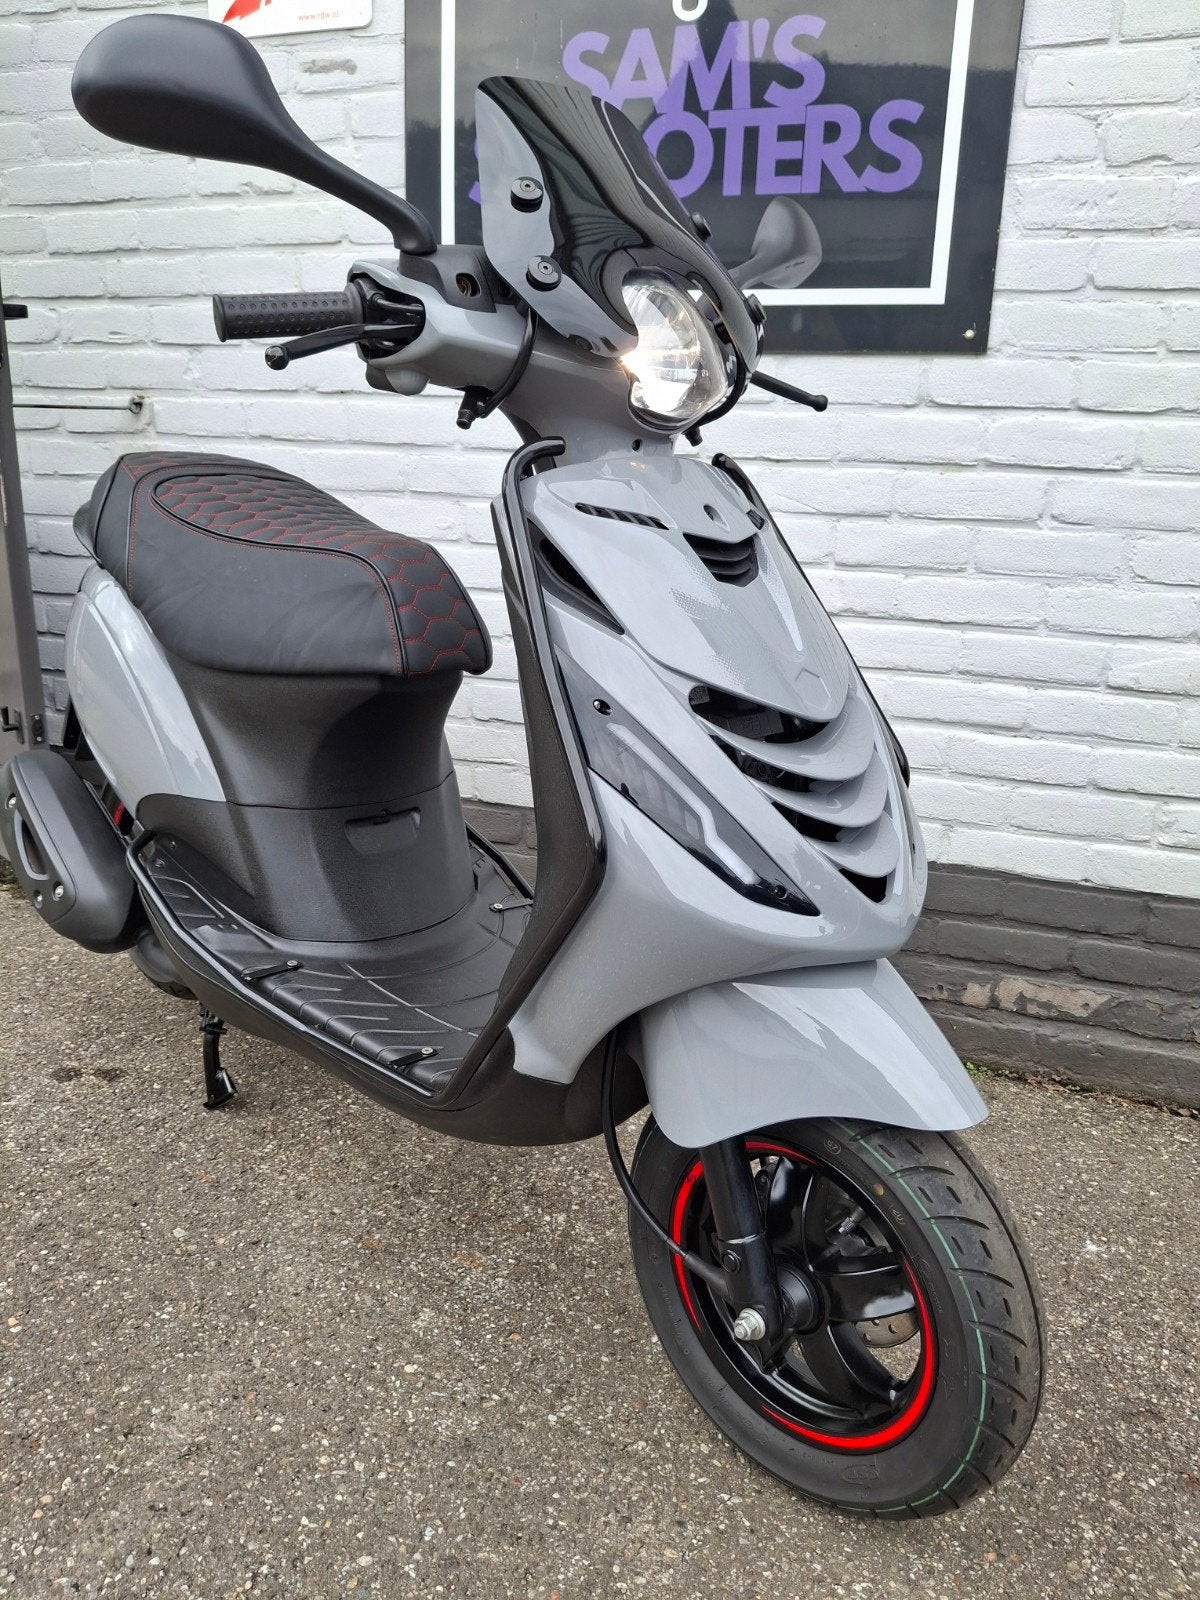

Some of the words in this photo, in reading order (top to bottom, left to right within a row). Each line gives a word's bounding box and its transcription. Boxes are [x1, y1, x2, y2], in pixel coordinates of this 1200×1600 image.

[298, 10, 340, 21] www.rdw.nl
[562, 14, 827, 115] SAM'S
[468, 98, 926, 206] OTERS
